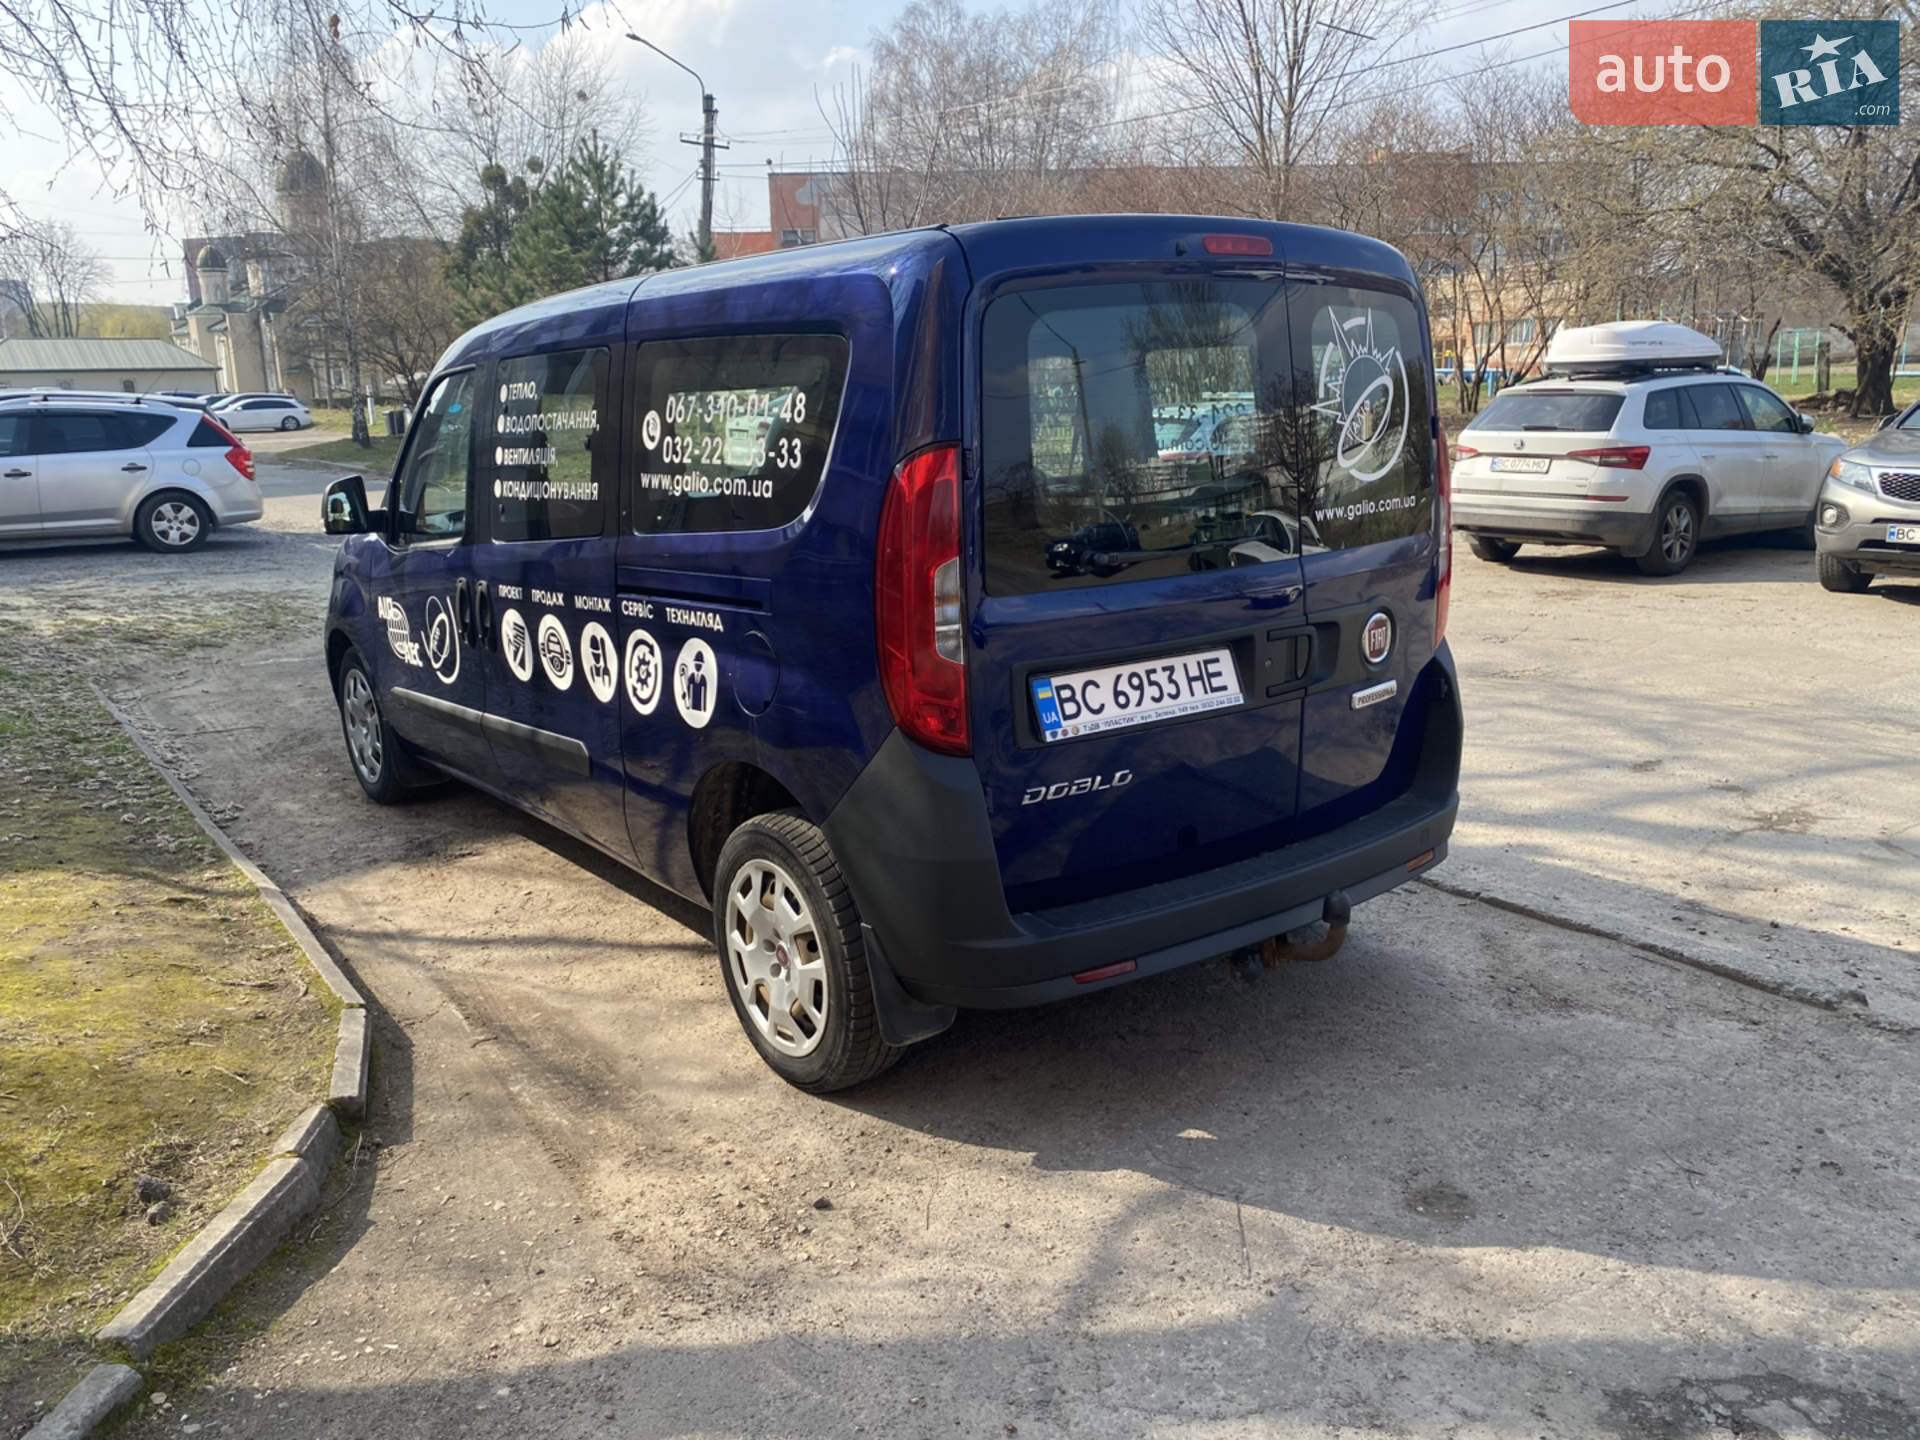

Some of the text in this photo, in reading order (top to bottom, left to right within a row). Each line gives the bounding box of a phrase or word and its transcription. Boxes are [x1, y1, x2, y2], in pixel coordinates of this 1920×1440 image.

[508, 381, 538, 400] ТЕПЛО,
[665, 392, 806, 424] 067-310-01-48
[662, 435, 802, 469] 032-22133-33
[640, 471, 773, 498] www.galio.com.ua
[1315, 495, 1416, 522] www.galio.com.ua
[1896, 528, 1916, 540] BC
[498, 584, 523, 600] ПРОЕКТ
[531, 589, 564, 607] ПРОДАЖ
[574, 595, 612, 613] МОНТАЖ
[665, 607, 724, 632] ТЕХНАГЛЯД
[1370, 626, 1387, 651] FIAT
[1055, 657, 1228, 721] BC 6953 HE
[1042, 711, 1059, 724] UA
[1021, 769, 1133, 805] DOBLO
